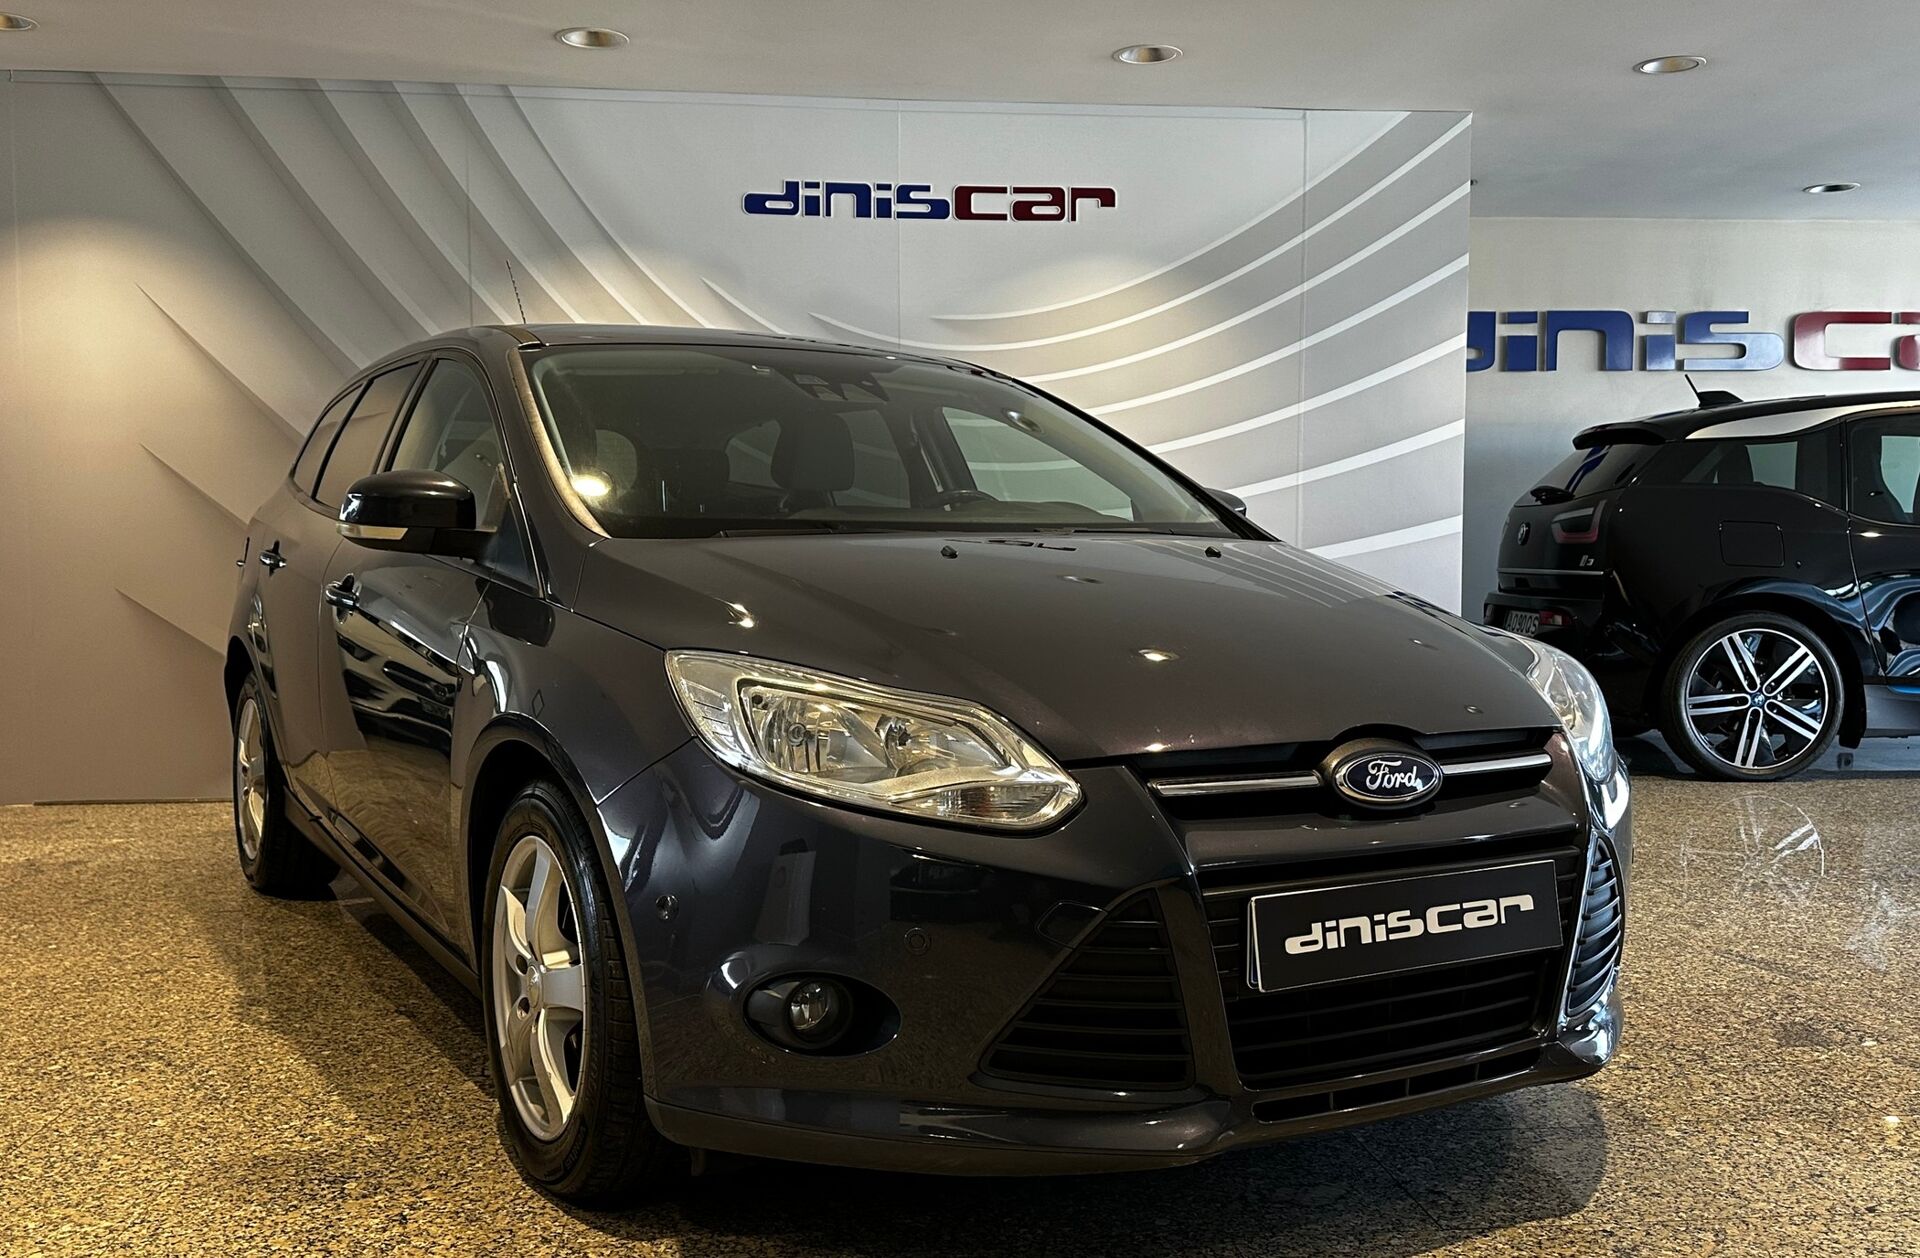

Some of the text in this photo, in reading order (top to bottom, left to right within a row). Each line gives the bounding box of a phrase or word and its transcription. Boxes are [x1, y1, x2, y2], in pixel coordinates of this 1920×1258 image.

[742, 180, 1118, 222] diniscar
[1466, 309, 1920, 372] inisc
[1365, 759, 1424, 791] Ford
[1284, 894, 1535, 955] diniscar
